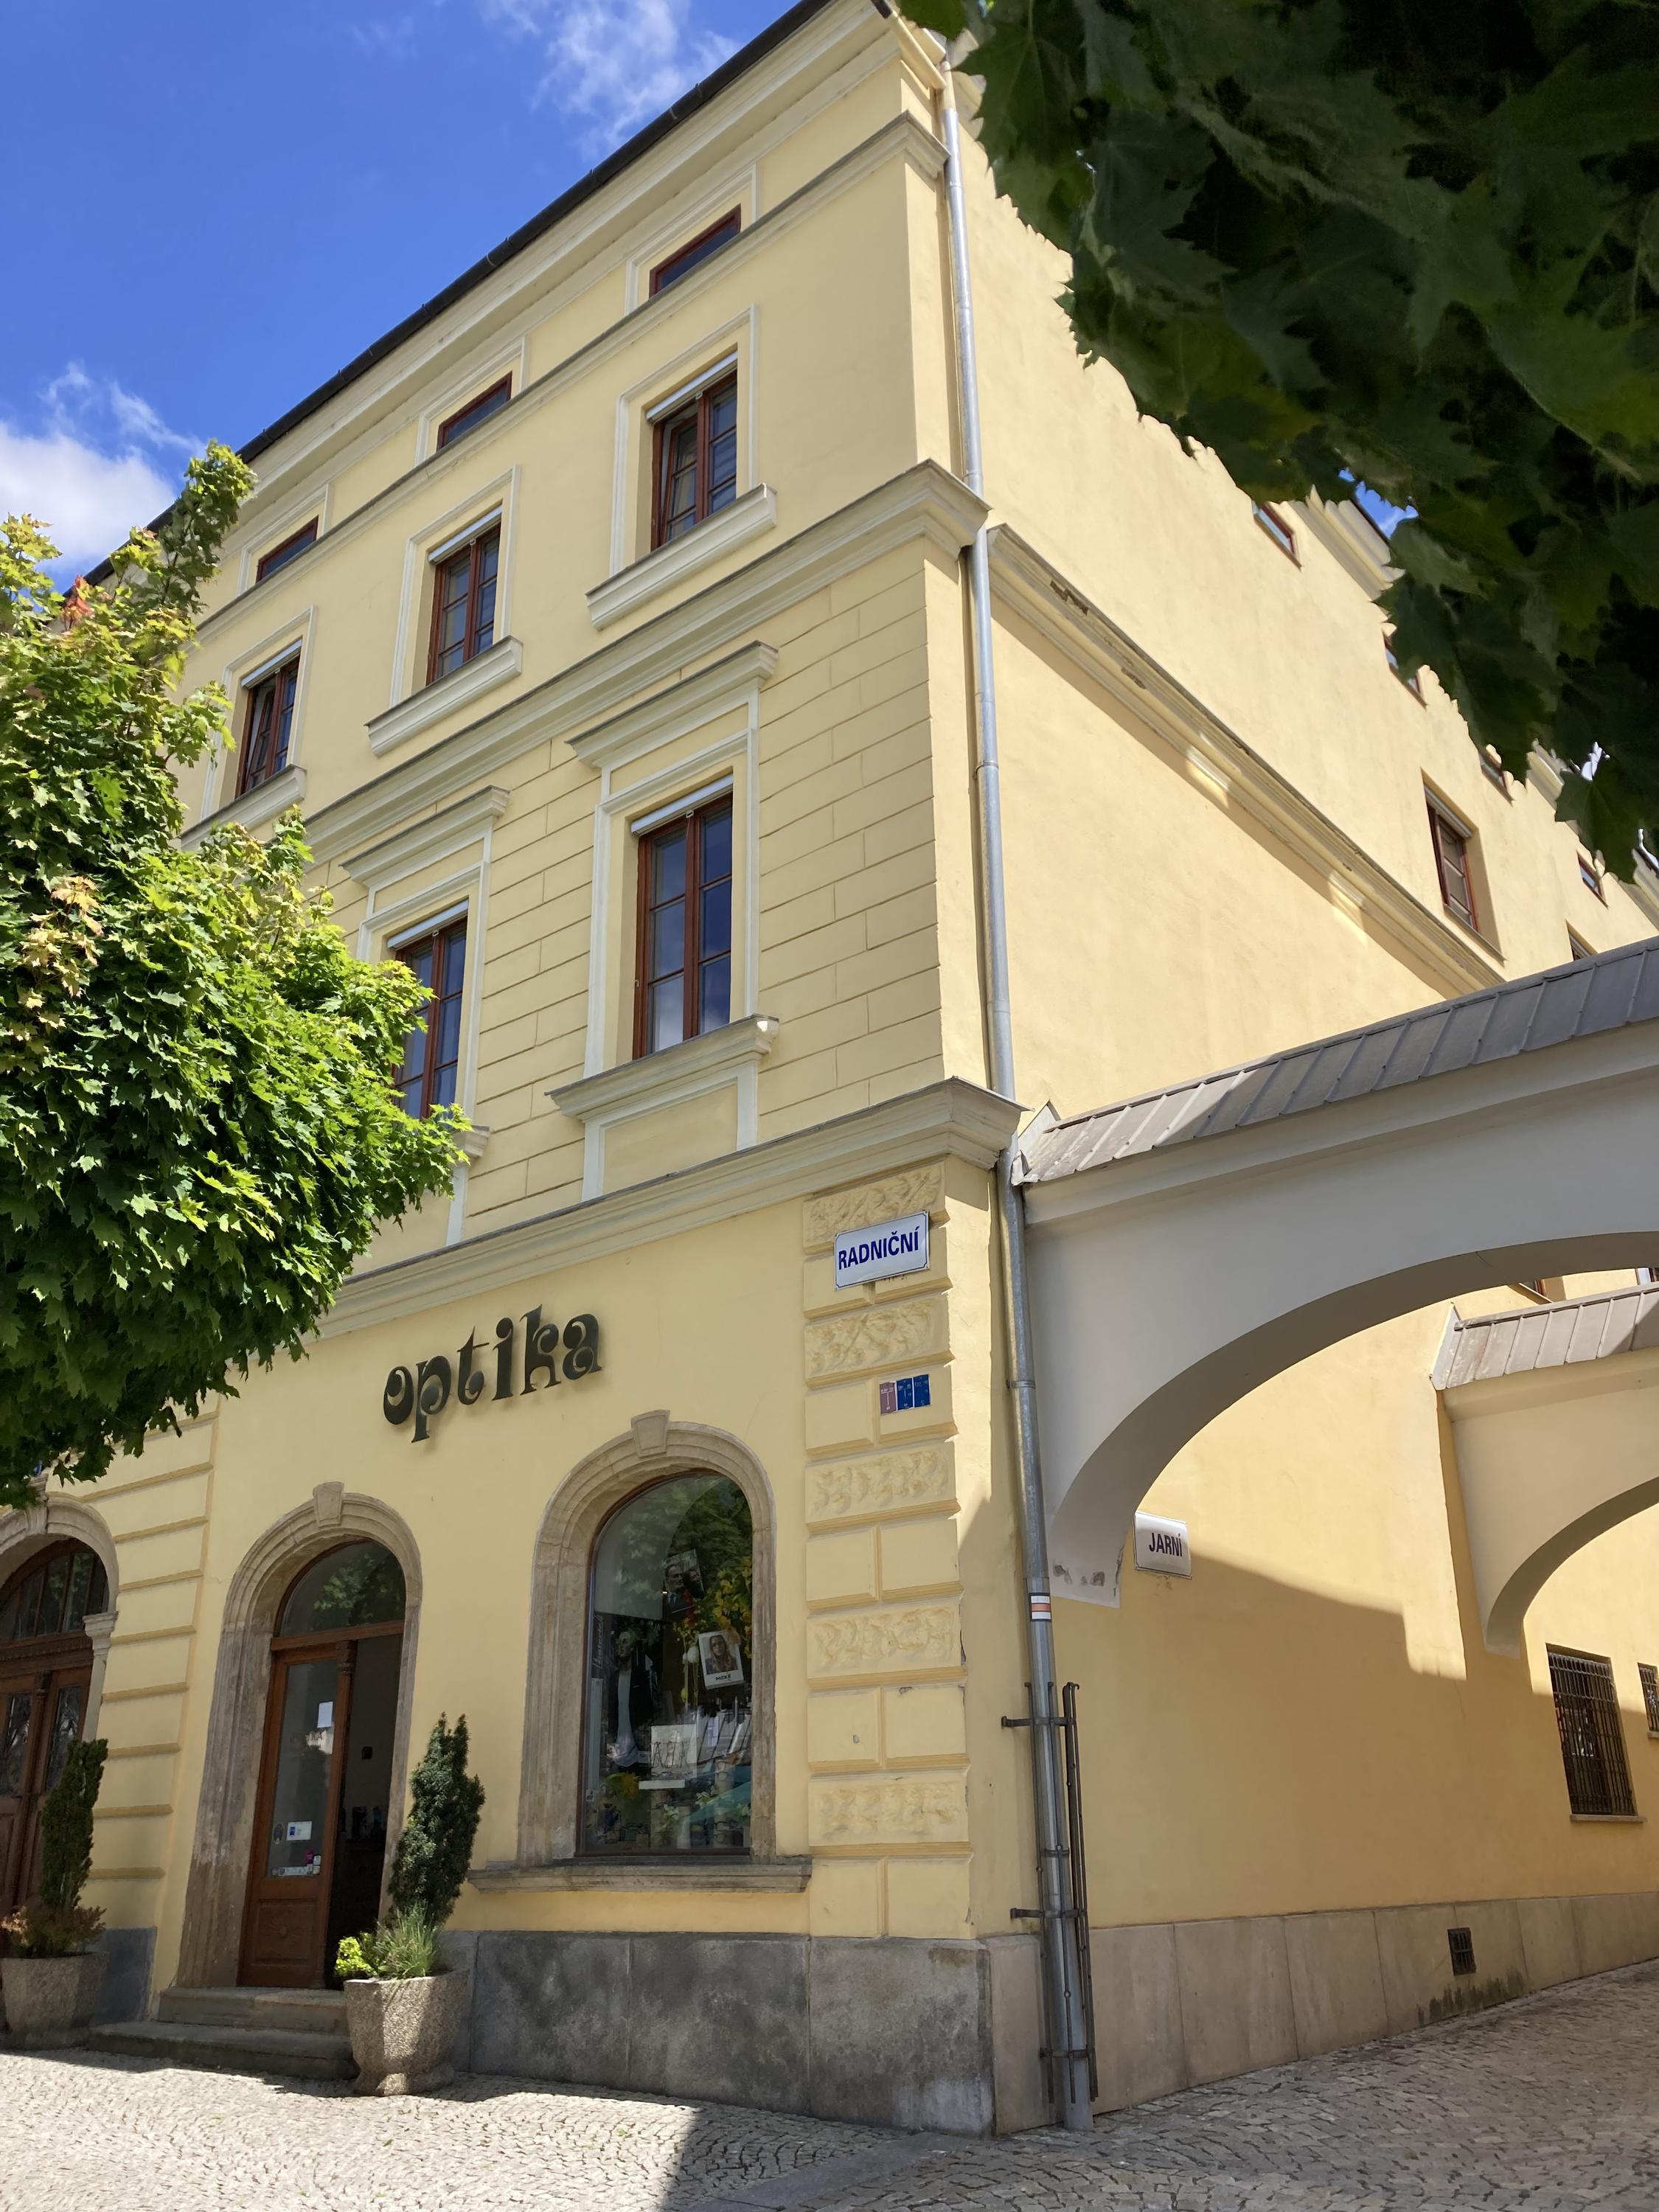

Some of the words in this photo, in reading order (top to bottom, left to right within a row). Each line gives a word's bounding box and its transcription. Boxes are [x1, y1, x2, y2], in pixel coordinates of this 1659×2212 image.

[838, 1225, 920, 1270] RADNIČNÍ
[383, 1303, 602, 1444] optika
[1149, 1533, 1183, 1557] JARNÍ
